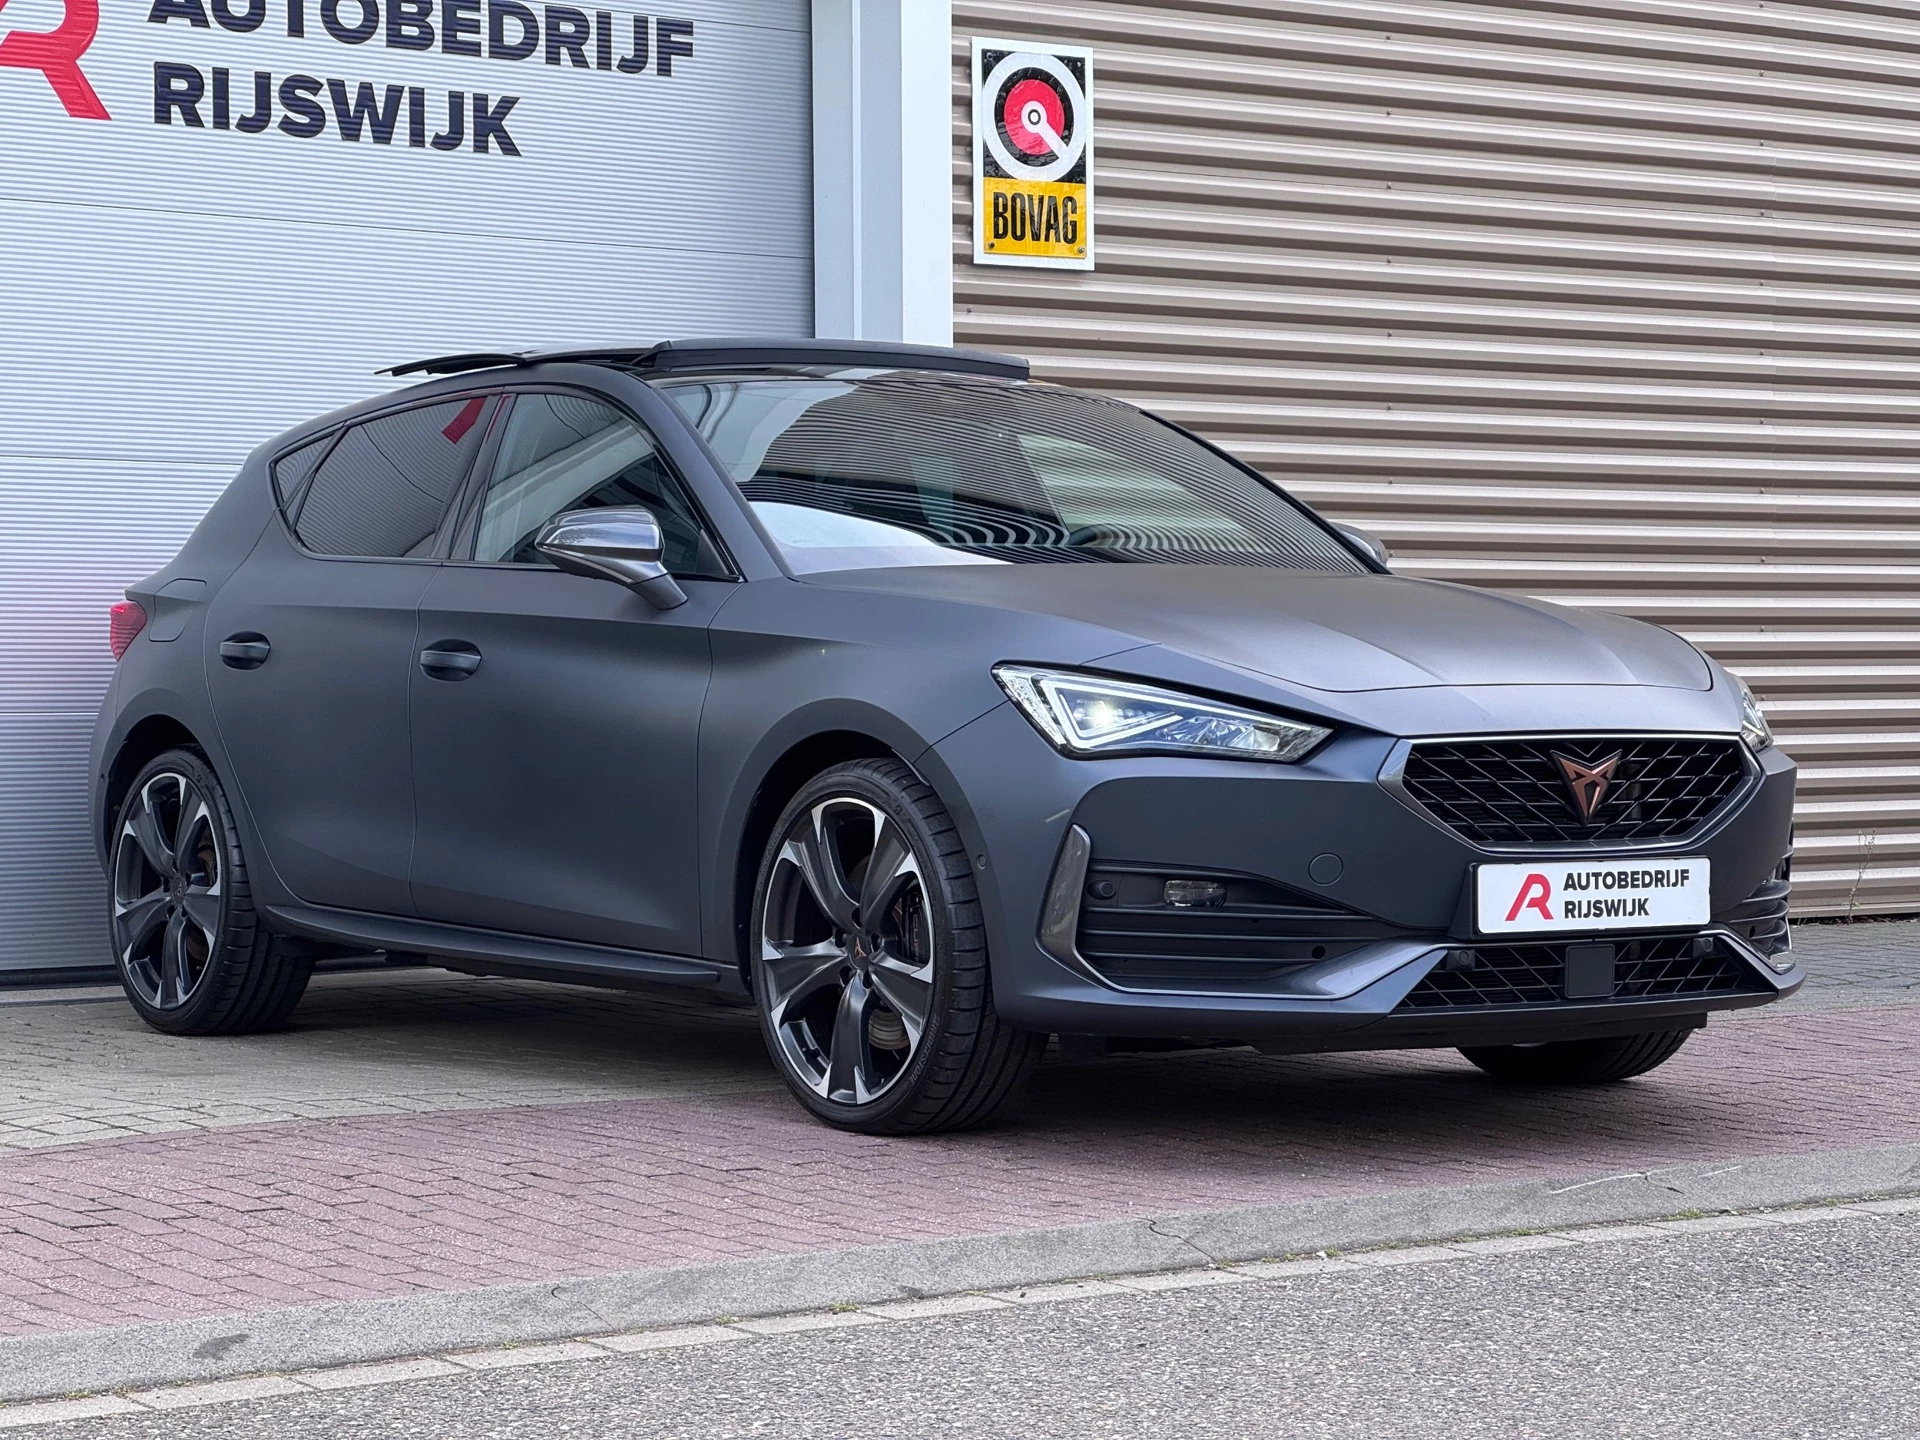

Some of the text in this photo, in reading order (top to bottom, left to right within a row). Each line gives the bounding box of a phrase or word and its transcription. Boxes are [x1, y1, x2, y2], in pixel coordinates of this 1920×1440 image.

[153, 61, 522, 157] RIJSWIJK
[993, 191, 1078, 244] BOVAG
[1563, 869, 1690, 891] AUTOBEDRIJF
[1564, 897, 1650, 919] RIJSWIJK
